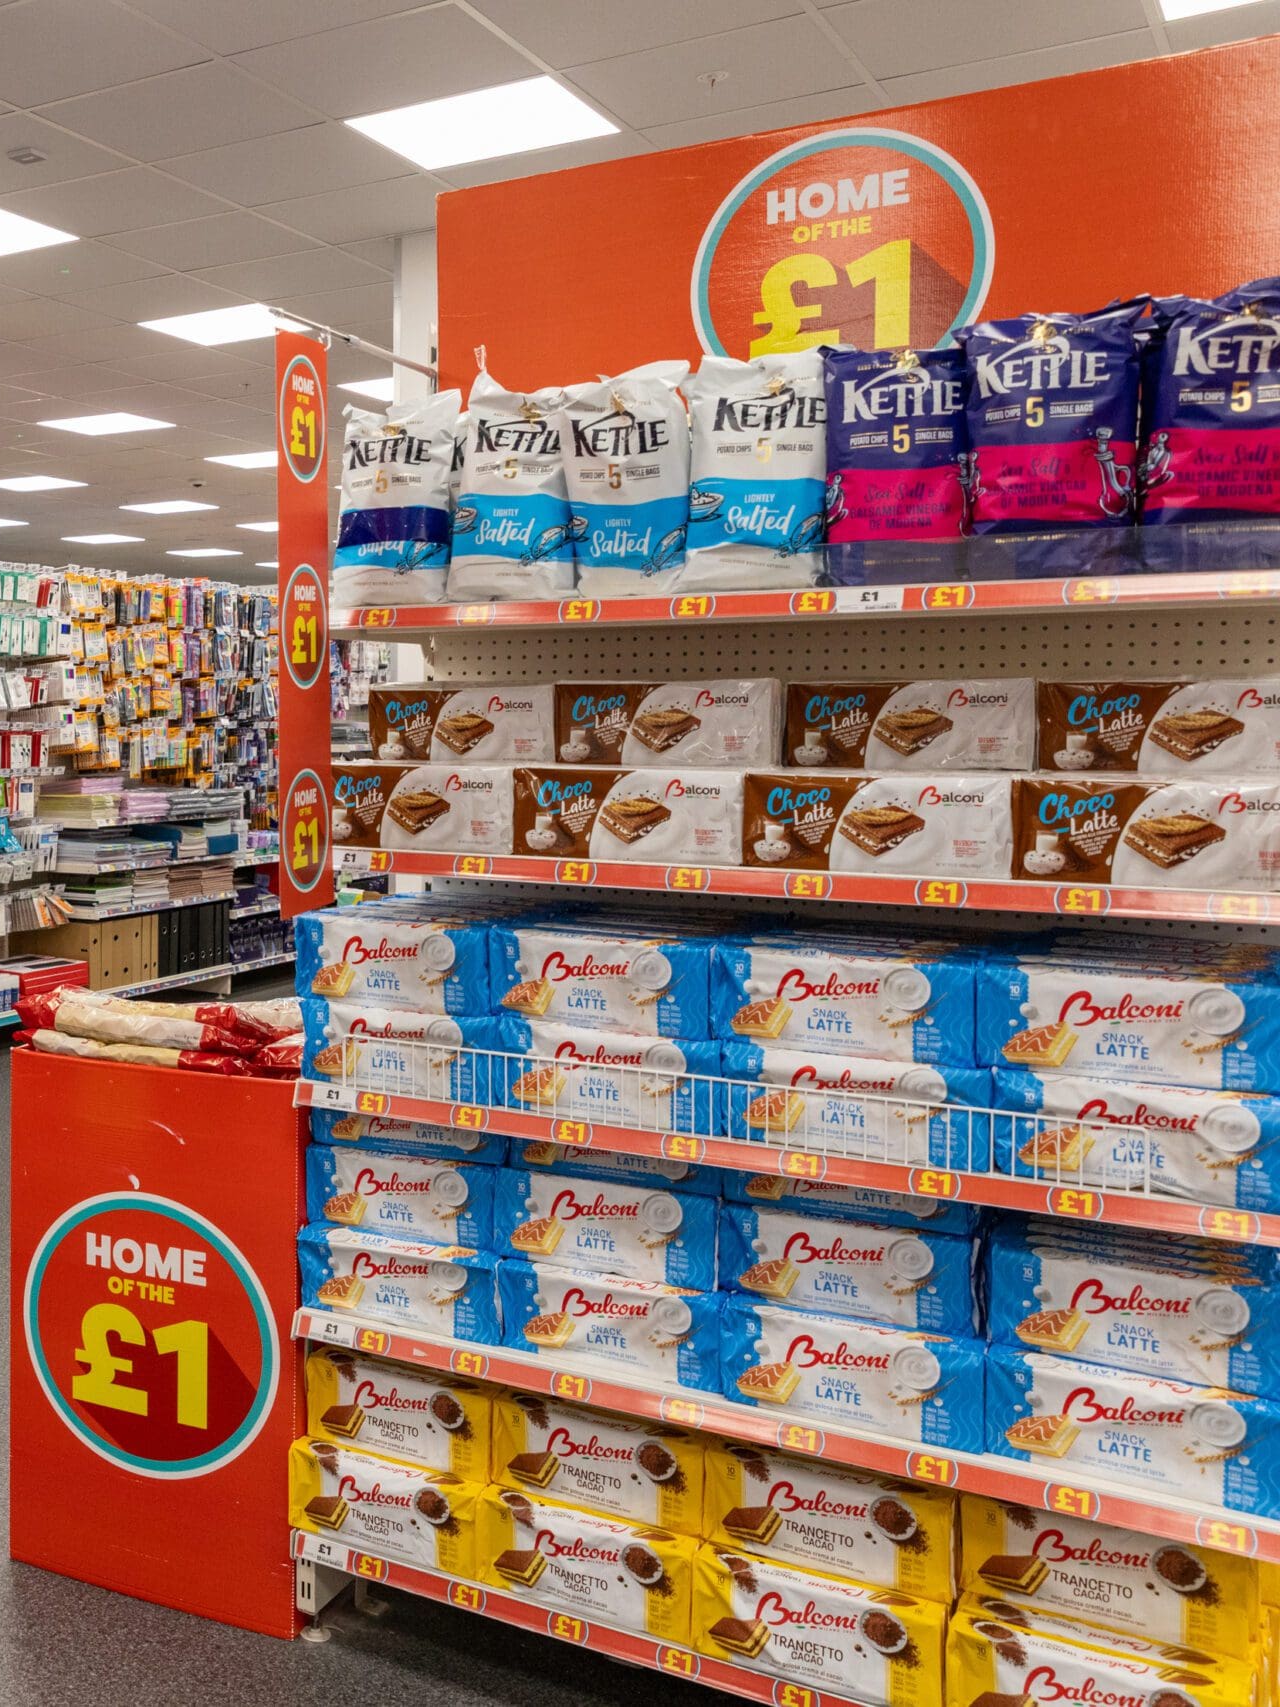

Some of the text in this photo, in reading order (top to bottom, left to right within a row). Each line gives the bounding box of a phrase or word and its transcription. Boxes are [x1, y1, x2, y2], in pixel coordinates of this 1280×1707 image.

[766, 168, 910, 225] HOME
[792, 215, 872, 244] OF THE
[749, 239, 911, 360] £1
[1172, 316, 1280, 377] KETT
[976, 337, 1110, 399] KETTLE
[291, 374, 315, 396] HOME
[842, 367, 963, 424] KETTLE
[1230, 381, 1252, 412] 5
[712, 388, 826, 432] KETTLE
[1025, 397, 1044, 427] 5
[1050, 405, 1073, 415] SINGLE
[1074, 403, 1093, 413] BAGS
[290, 406, 315, 458] £1
[571, 410, 669, 457] KETTLE
[850, 425, 953, 453] POTATO CHIPS 5 SINGLE BAGS
[348, 428, 432, 470] KETTLE
[754, 438, 772, 463] 5
[608, 464, 622, 489] 5
[744, 494, 775, 503] LIGHTLY
[493, 508, 519, 518] LIGHTLY
[605, 519, 631, 528] LIGHTLY
[724, 505, 796, 535] Salted
[476, 518, 535, 546] Salted
[590, 527, 651, 557] Salted
[294, 585, 316, 601] HOME
[861, 591, 879, 602] £1
[931, 586, 965, 607] £1
[365, 609, 390, 627] £1
[566, 601, 593, 619] £1
[292, 615, 317, 664] £1
[488, 696, 533, 714] Balconi
[804, 693, 865, 724] Choco
[947, 688, 1008, 708] Balconi
[385, 698, 429, 723] Choco
[404, 713, 431, 732] Latte
[831, 708, 870, 731] Latte
[294, 788, 317, 808] HOME
[537, 779, 593, 807] Choco
[665, 779, 720, 799] Balconi
[561, 796, 596, 816] Latte
[292, 817, 318, 870] £1
[343, 853, 356, 863] £1
[562, 863, 589, 881] £1
[792, 874, 824, 896] £1
[1059, 990, 1184, 1026] Balconi
[1101, 1032, 1144, 1045] SNACK
[1096, 1043, 1149, 1060] LATTE
[360, 1092, 384, 1113] £1
[558, 1122, 586, 1143] £1
[918, 1171, 951, 1195] £1
[551, 1190, 639, 1220] Balconi
[576, 1236, 616, 1252] LATTE
[581, 1227, 612, 1239] SNACK
[86, 1231, 207, 1287] HOME
[108, 1276, 175, 1305] OF THE
[325, 1323, 338, 1334] £1
[786, 1335, 890, 1369] Balconi
[72, 1303, 208, 1430] £1
[457, 1354, 483, 1375] £1
[821, 1376, 857, 1391] SNACK
[354, 1380, 429, 1412] Balconi
[815, 1386, 861, 1406] LATTE
[366, 1415, 419, 1438] TRANCETTO
[380, 1431, 404, 1442] CACAO
[916, 1456, 949, 1482] £1
[767, 1481, 869, 1518] Balconi
[784, 1519, 854, 1548] TRANCETTO
[802, 1536, 834, 1552] CACAO
[555, 1616, 582, 1639] £1
